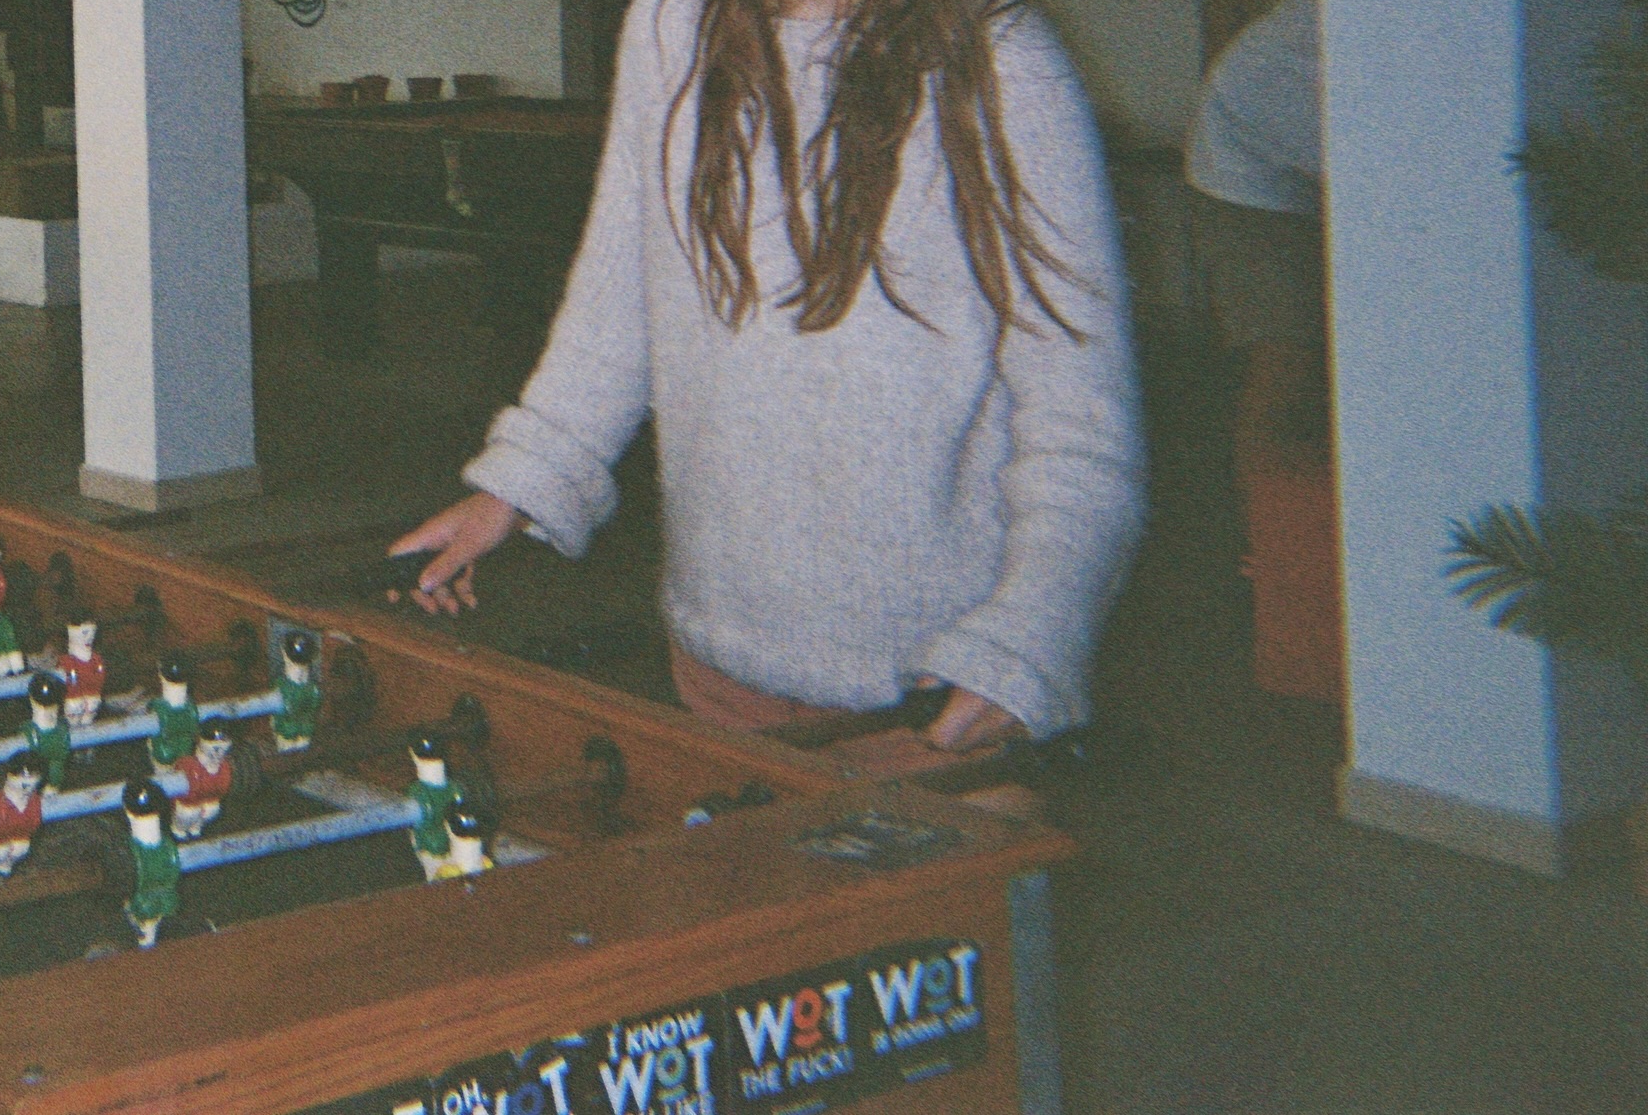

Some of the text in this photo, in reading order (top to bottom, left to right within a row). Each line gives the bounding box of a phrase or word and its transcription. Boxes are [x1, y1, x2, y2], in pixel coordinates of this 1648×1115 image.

[736, 980, 852, 1066] WOT
[868, 945, 979, 1027] WOT
[598, 1033, 715, 1115] WOT
[626, 1009, 705, 1057] KNOW
[472, 1056, 569, 1115] OT
